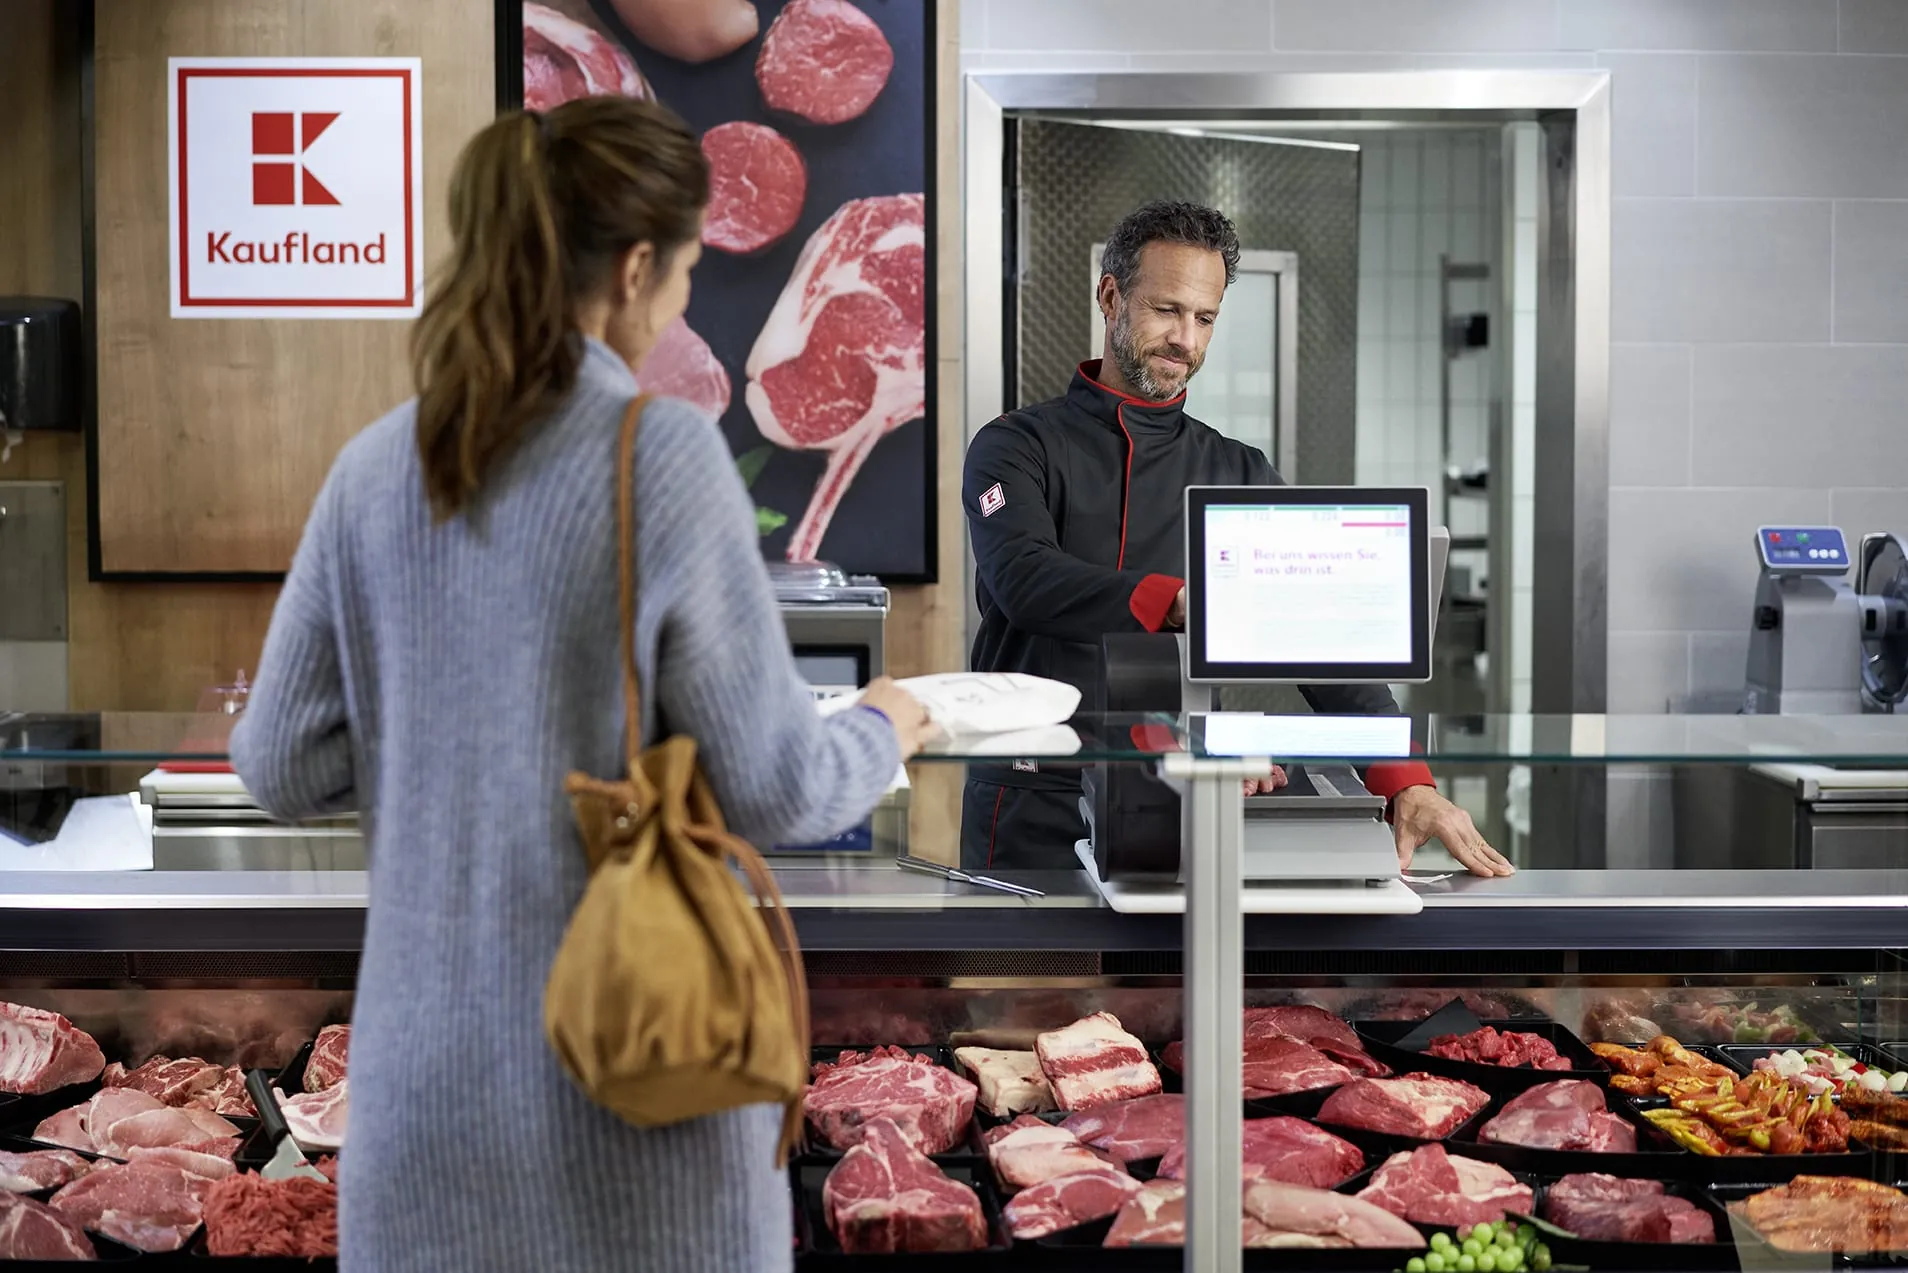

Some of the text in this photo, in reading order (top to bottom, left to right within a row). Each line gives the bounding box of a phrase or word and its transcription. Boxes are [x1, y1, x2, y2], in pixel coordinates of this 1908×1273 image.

[207, 231, 386, 264] Kaufland
[1253, 549, 1276, 561] Bei
[1280, 551, 1304, 561] uns
[1307, 550, 1354, 561] wissen
[1254, 566, 1280, 576] was
[1284, 564, 1312, 576] drin
